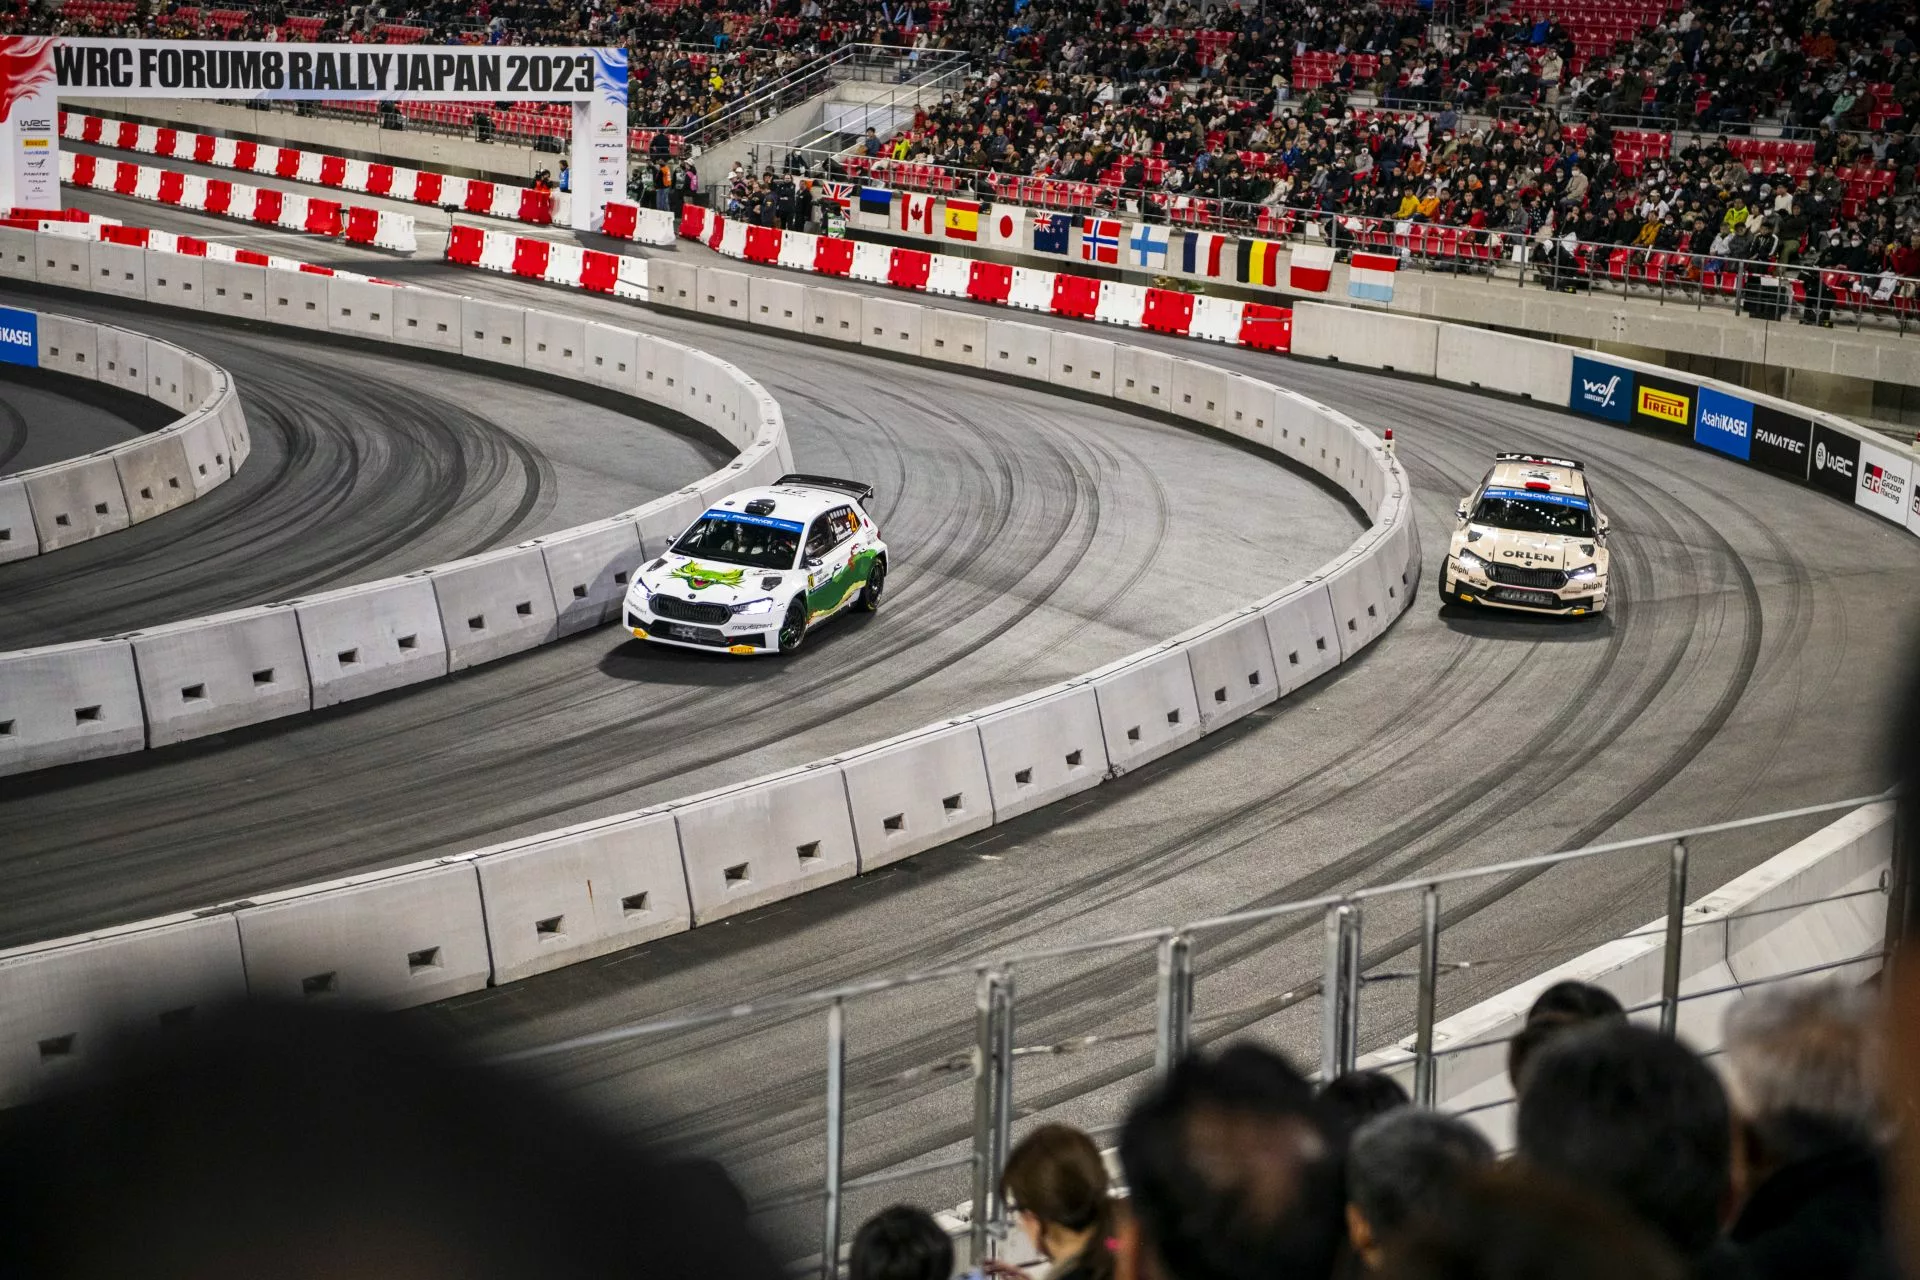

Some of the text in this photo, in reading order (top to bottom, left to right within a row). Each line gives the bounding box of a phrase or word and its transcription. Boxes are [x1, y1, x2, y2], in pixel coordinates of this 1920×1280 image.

[54, 45, 595, 92] WRC FORUM8 RALLY JAPAN 2023
[1583, 375, 1621, 407] wolf
[1643, 392, 1684, 418] PIRELLI
[1701, 409, 1748, 438] AsahiKASEI
[1755, 429, 1805, 454] FANATEC
[1826, 451, 1854, 477] WRC
[1862, 472, 1882, 493] GR
[1881, 479, 1902, 493] GAZOO
[1883, 470, 1905, 486] TOYOTA
[1880, 487, 1900, 504] Racing
[1503, 550, 1555, 563] ORLEN
[1450, 562, 1470, 576] Delphi
[1582, 582, 1604, 591] Delphi
